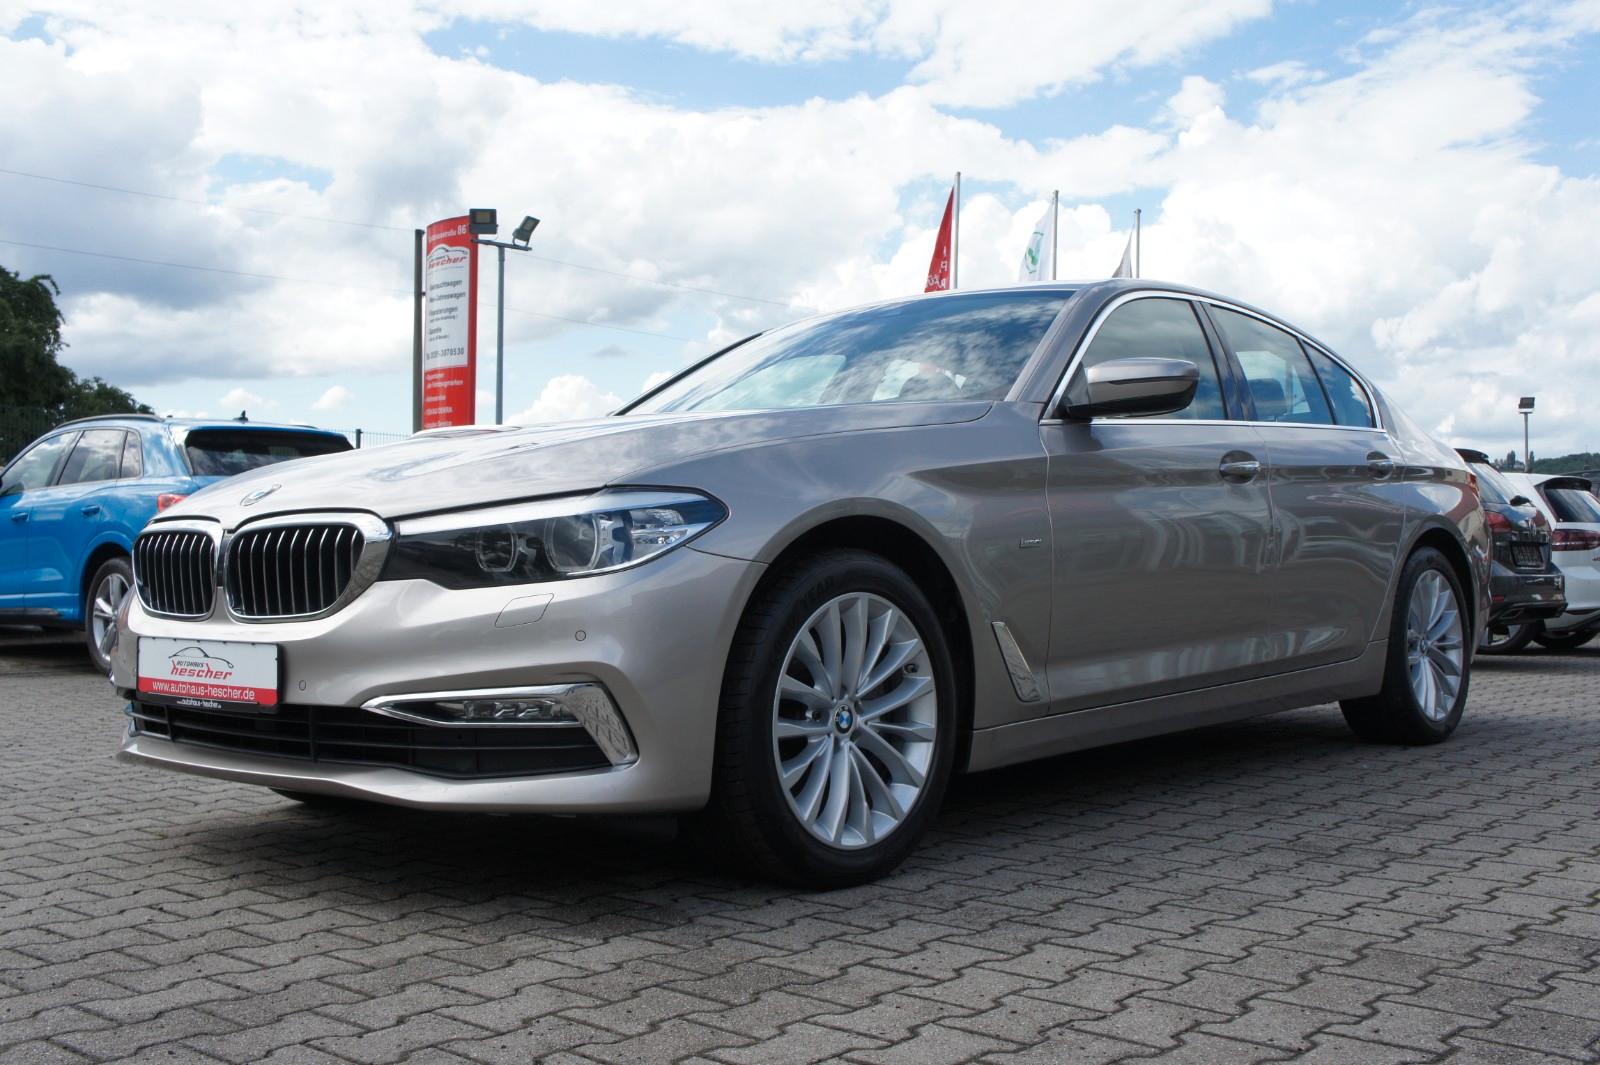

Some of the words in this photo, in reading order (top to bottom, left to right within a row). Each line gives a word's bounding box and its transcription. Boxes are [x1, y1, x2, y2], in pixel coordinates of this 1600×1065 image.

[170, 659, 232, 680] hescher
[176, 660, 205, 668] AUTOHAUS
[152, 680, 255, 700] www.autohaus-hescher.de
